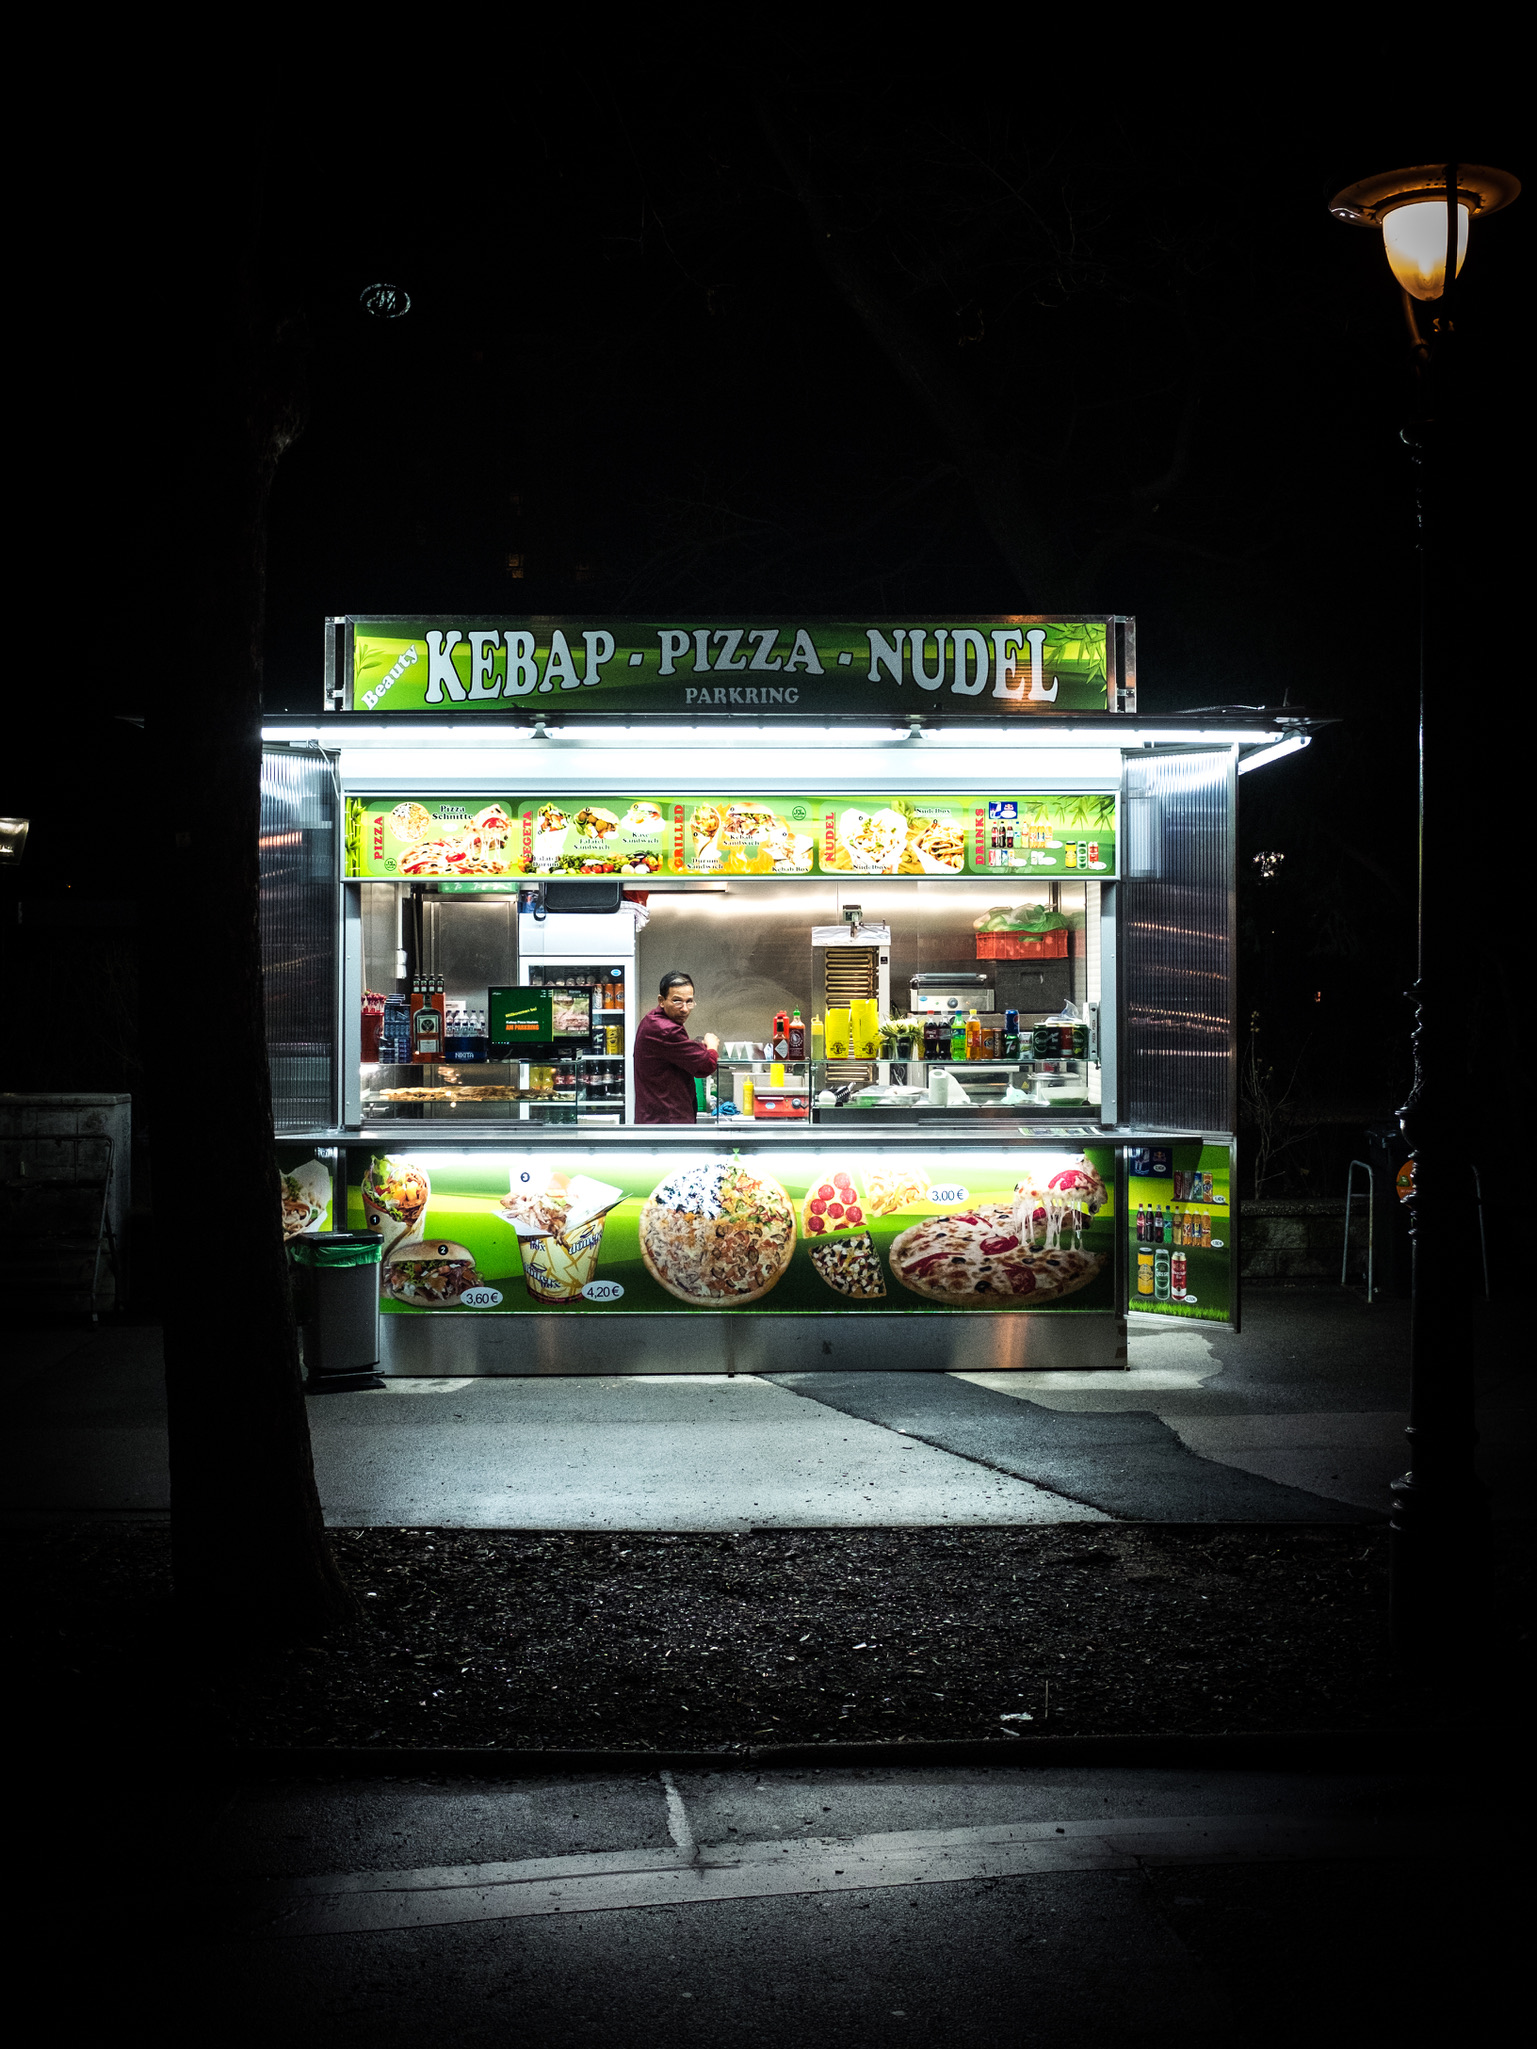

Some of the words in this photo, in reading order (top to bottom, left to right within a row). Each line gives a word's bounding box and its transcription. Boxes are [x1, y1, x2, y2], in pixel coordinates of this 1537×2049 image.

[361, 644, 419, 710] Beauty
[425, 629, 616, 703] KEBAP
[657, 629, 825, 675] PIZZA
[866, 628, 1059, 702] NUDEL
[685, 687, 800, 704] PARKRING
[440, 805, 466, 813] Pizza
[374, 816, 384, 860] PIZZA
[674, 804, 684, 868] GRILLED
[825, 812, 835, 862] NUDEL
[975, 808, 985, 865] DRINKS
